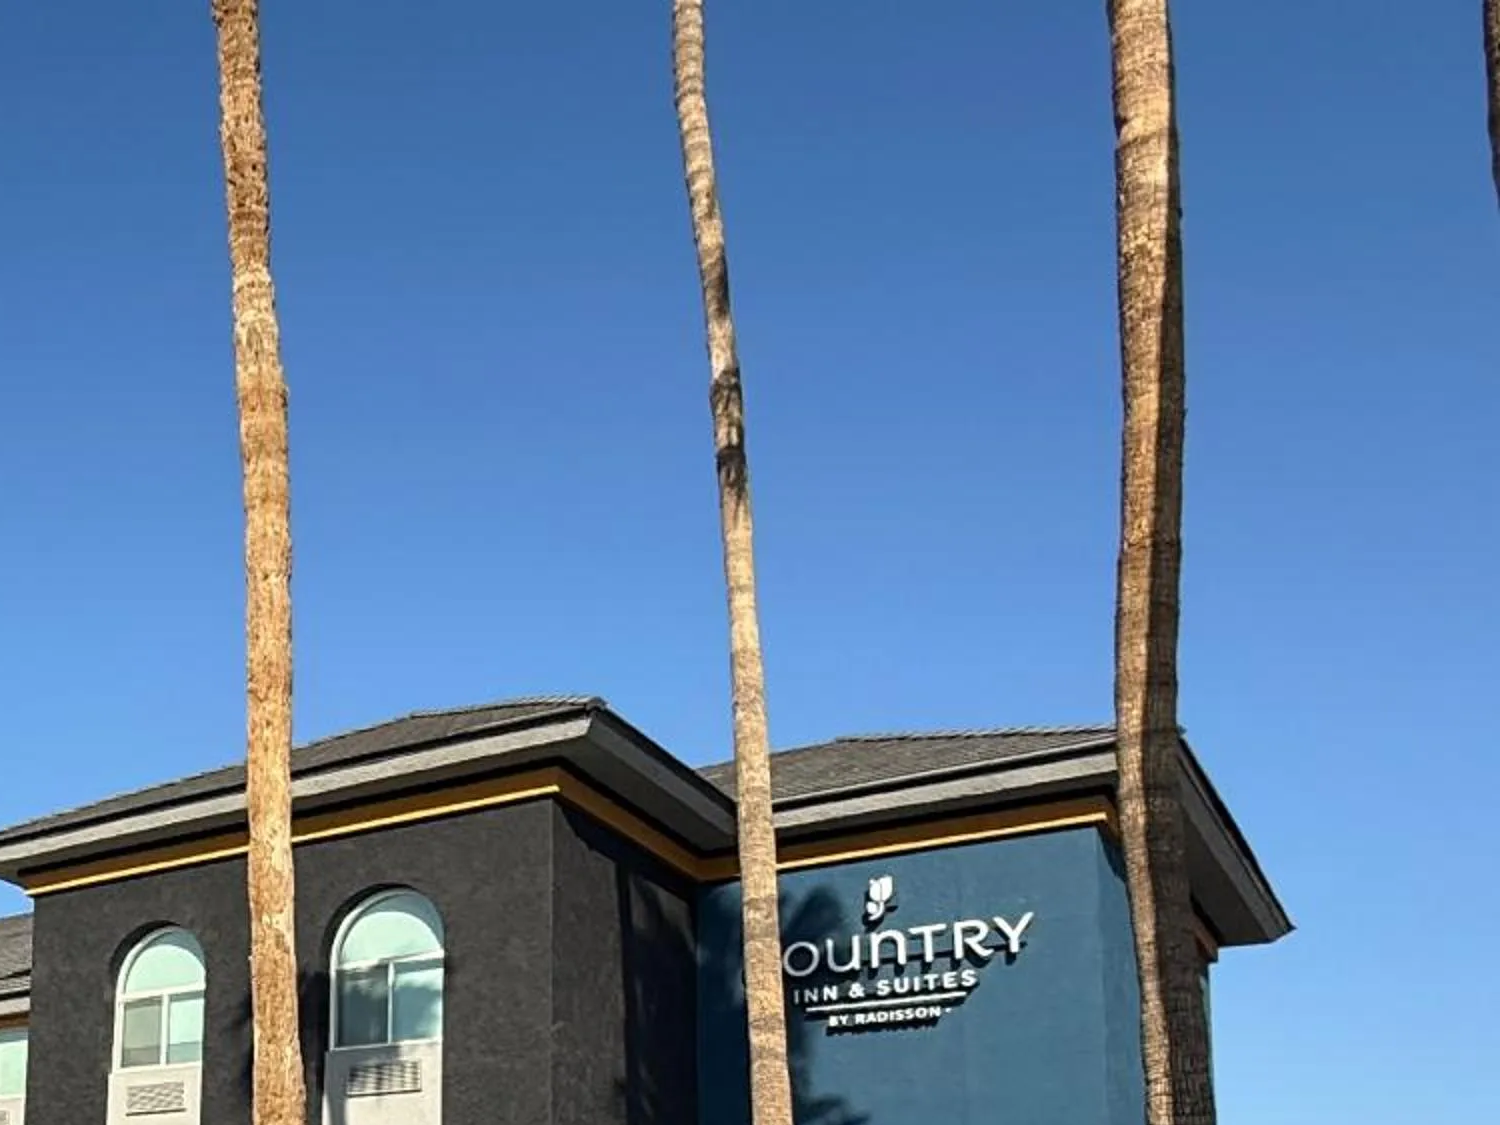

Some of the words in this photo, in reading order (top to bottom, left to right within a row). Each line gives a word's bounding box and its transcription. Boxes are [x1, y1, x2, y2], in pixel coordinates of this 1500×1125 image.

[782, 911, 1035, 977] OUNTRY
[793, 985, 838, 1005] INN
[848, 982, 866, 999] &
[876, 969, 978, 997] SUITES
[828, 1014, 850, 1027] BY
[855, 1006, 942, 1025] RADISSON
